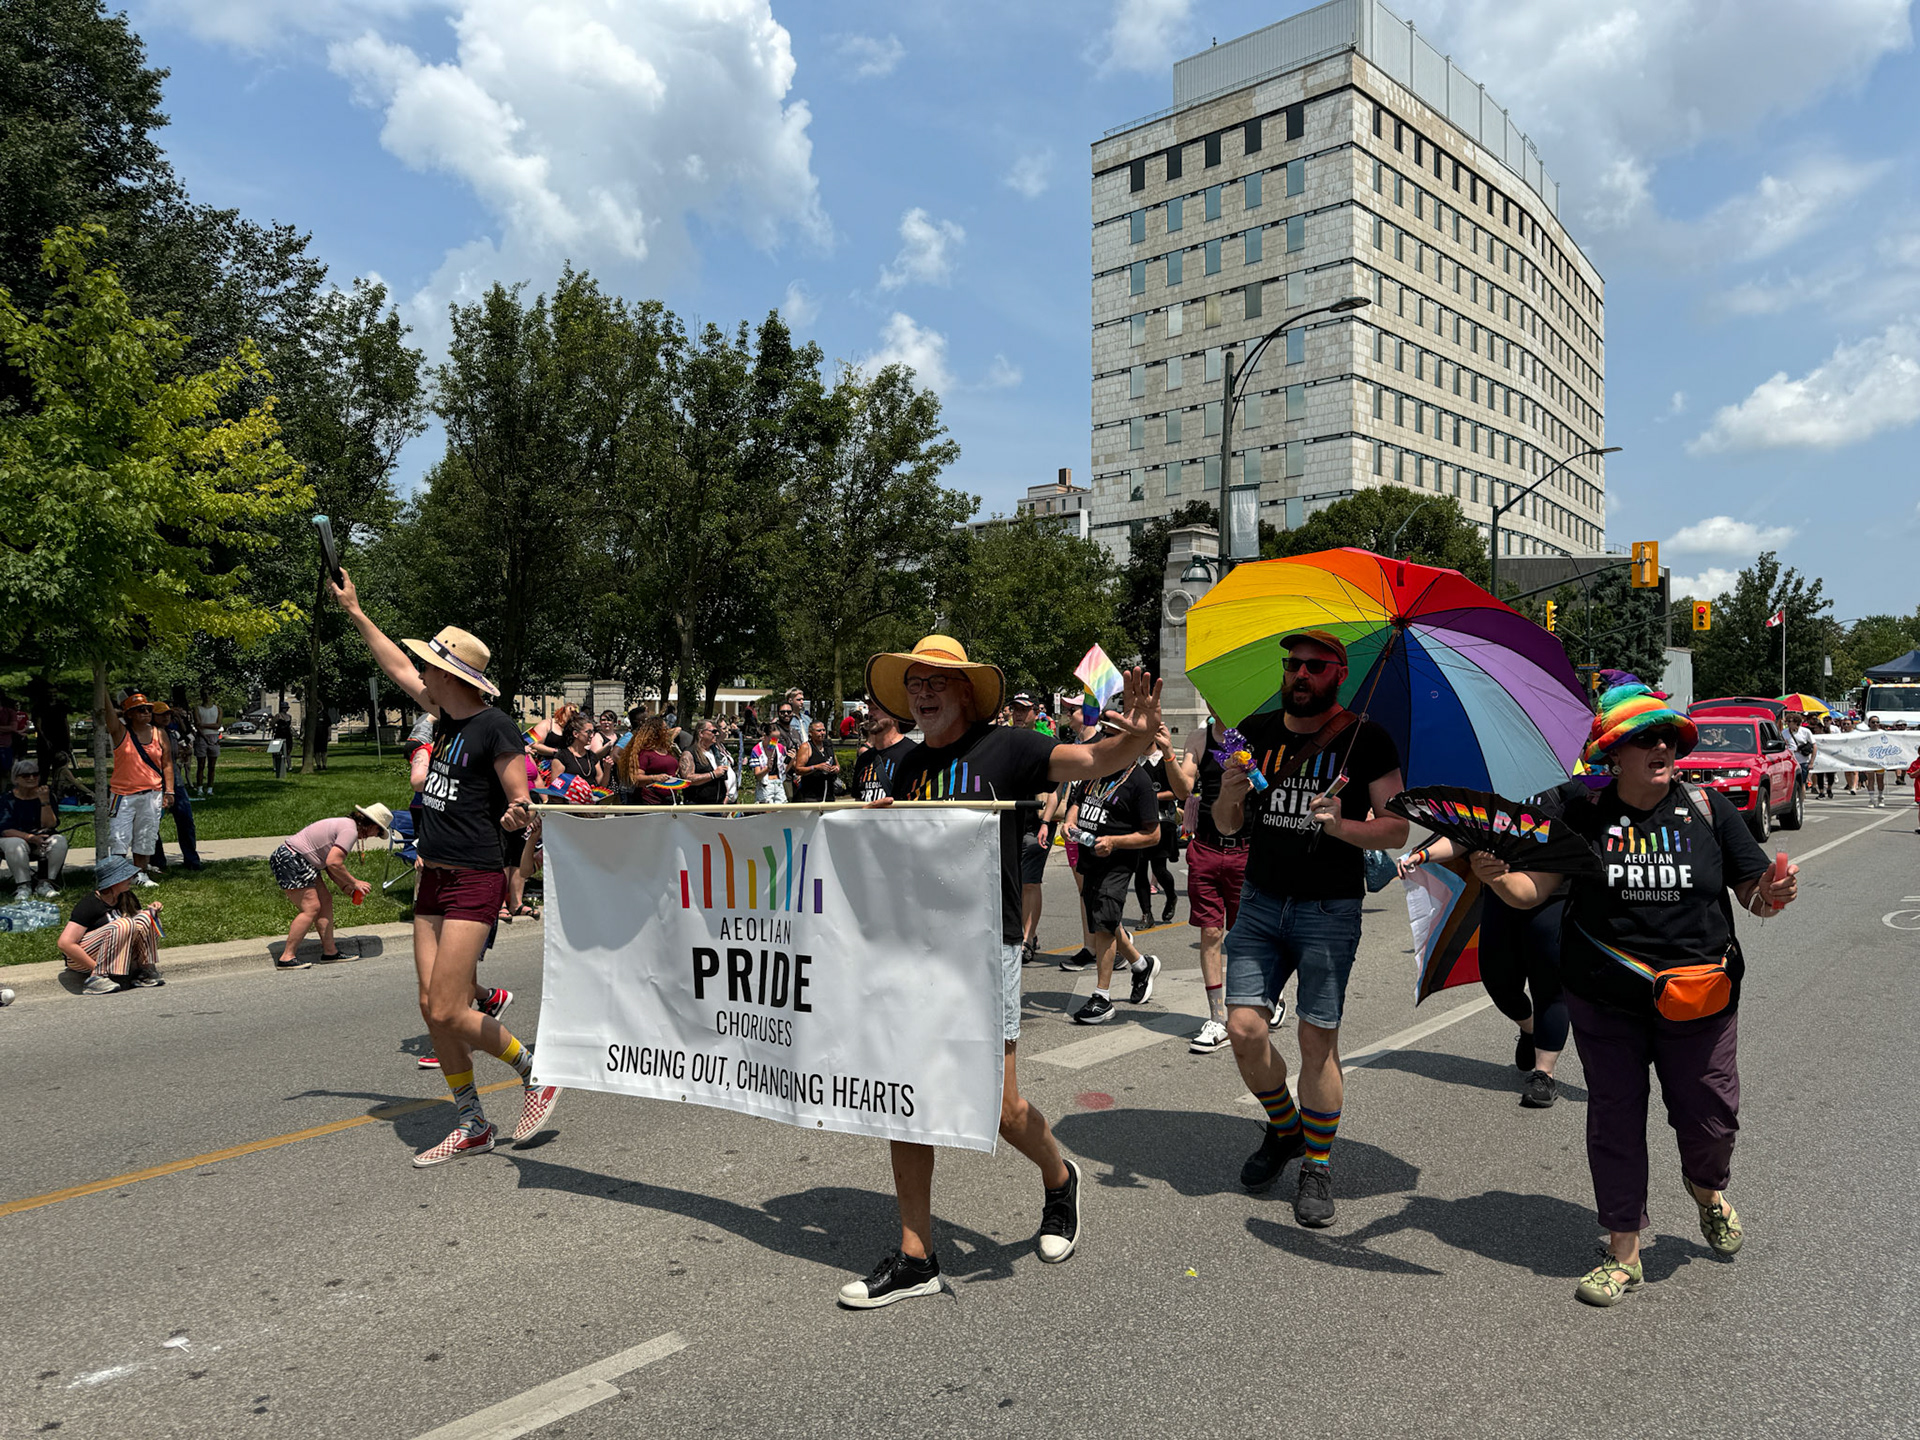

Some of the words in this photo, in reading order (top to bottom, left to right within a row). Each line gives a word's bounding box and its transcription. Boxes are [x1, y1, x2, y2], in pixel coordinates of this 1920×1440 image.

[425, 771, 460, 801] RIDE
[1280, 777, 1320, 791] OLIAN
[1080, 802, 1110, 825] RIDE
[1268, 788, 1317, 815] RID
[1624, 853, 1674, 864] AEOLIAN
[1607, 864, 1694, 889] PRIDE
[1621, 889, 1681, 902] CHORUSES
[720, 917, 791, 945] AEOLIAN
[692, 947, 812, 1013] PRIDE
[716, 1010, 792, 1047] CHORUSES
[606, 1044, 686, 1080] SINGING
[691, 1052, 731, 1092] OUT,
[736, 1059, 824, 1105] CHANGING
[832, 1075, 915, 1118] HEARTS
